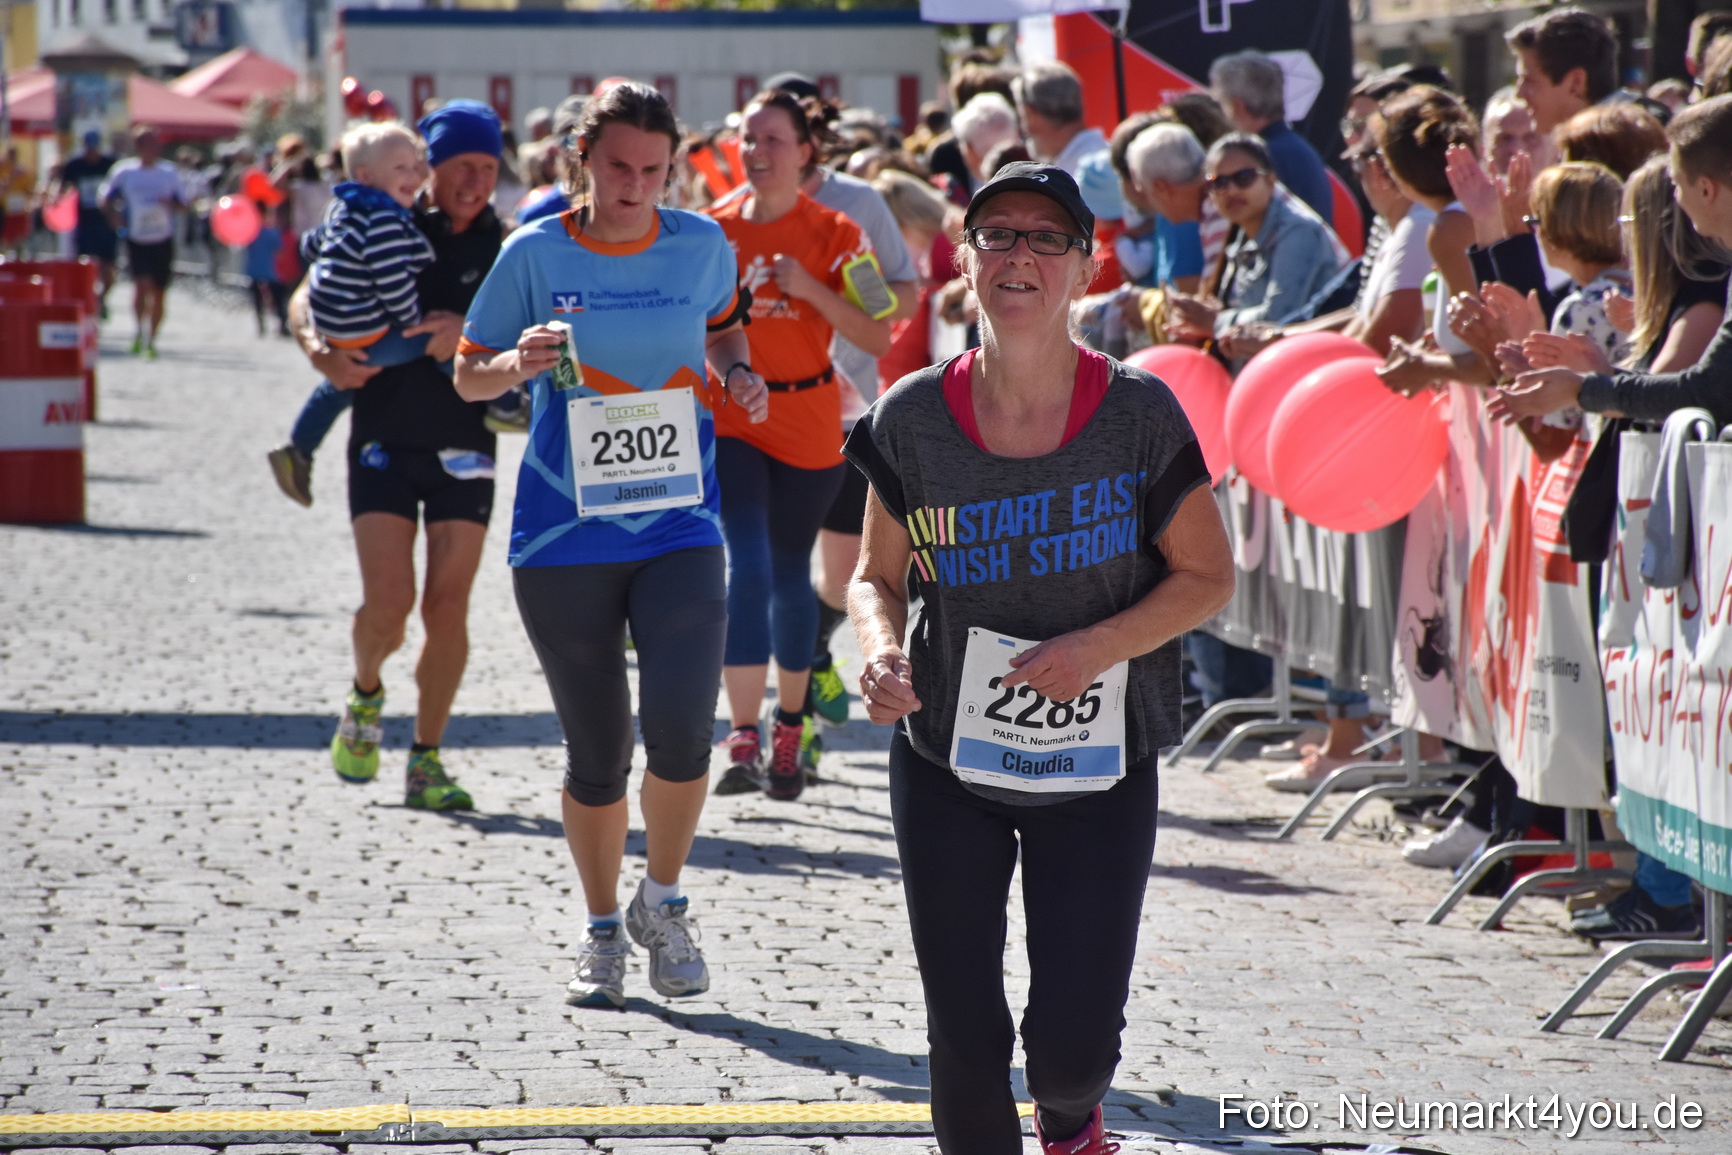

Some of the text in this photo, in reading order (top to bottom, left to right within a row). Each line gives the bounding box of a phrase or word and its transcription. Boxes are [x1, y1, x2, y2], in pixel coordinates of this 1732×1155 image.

[588, 288, 661, 300] Raiffeisenbank
[590, 301, 639, 312] Neumarkt
[605, 403, 660, 420] BOCK
[591, 423, 680, 466] 2302
[602, 466, 665, 479] PARTL Neumarkt
[614, 482, 667, 501] Jasmin
[957, 490, 1056, 544] START
[967, 705, 975, 714] D
[984, 676, 1104, 729] 2285
[992, 728, 1076, 746] PARTL Neumarkt
[1002, 751, 1075, 776] Claudia
